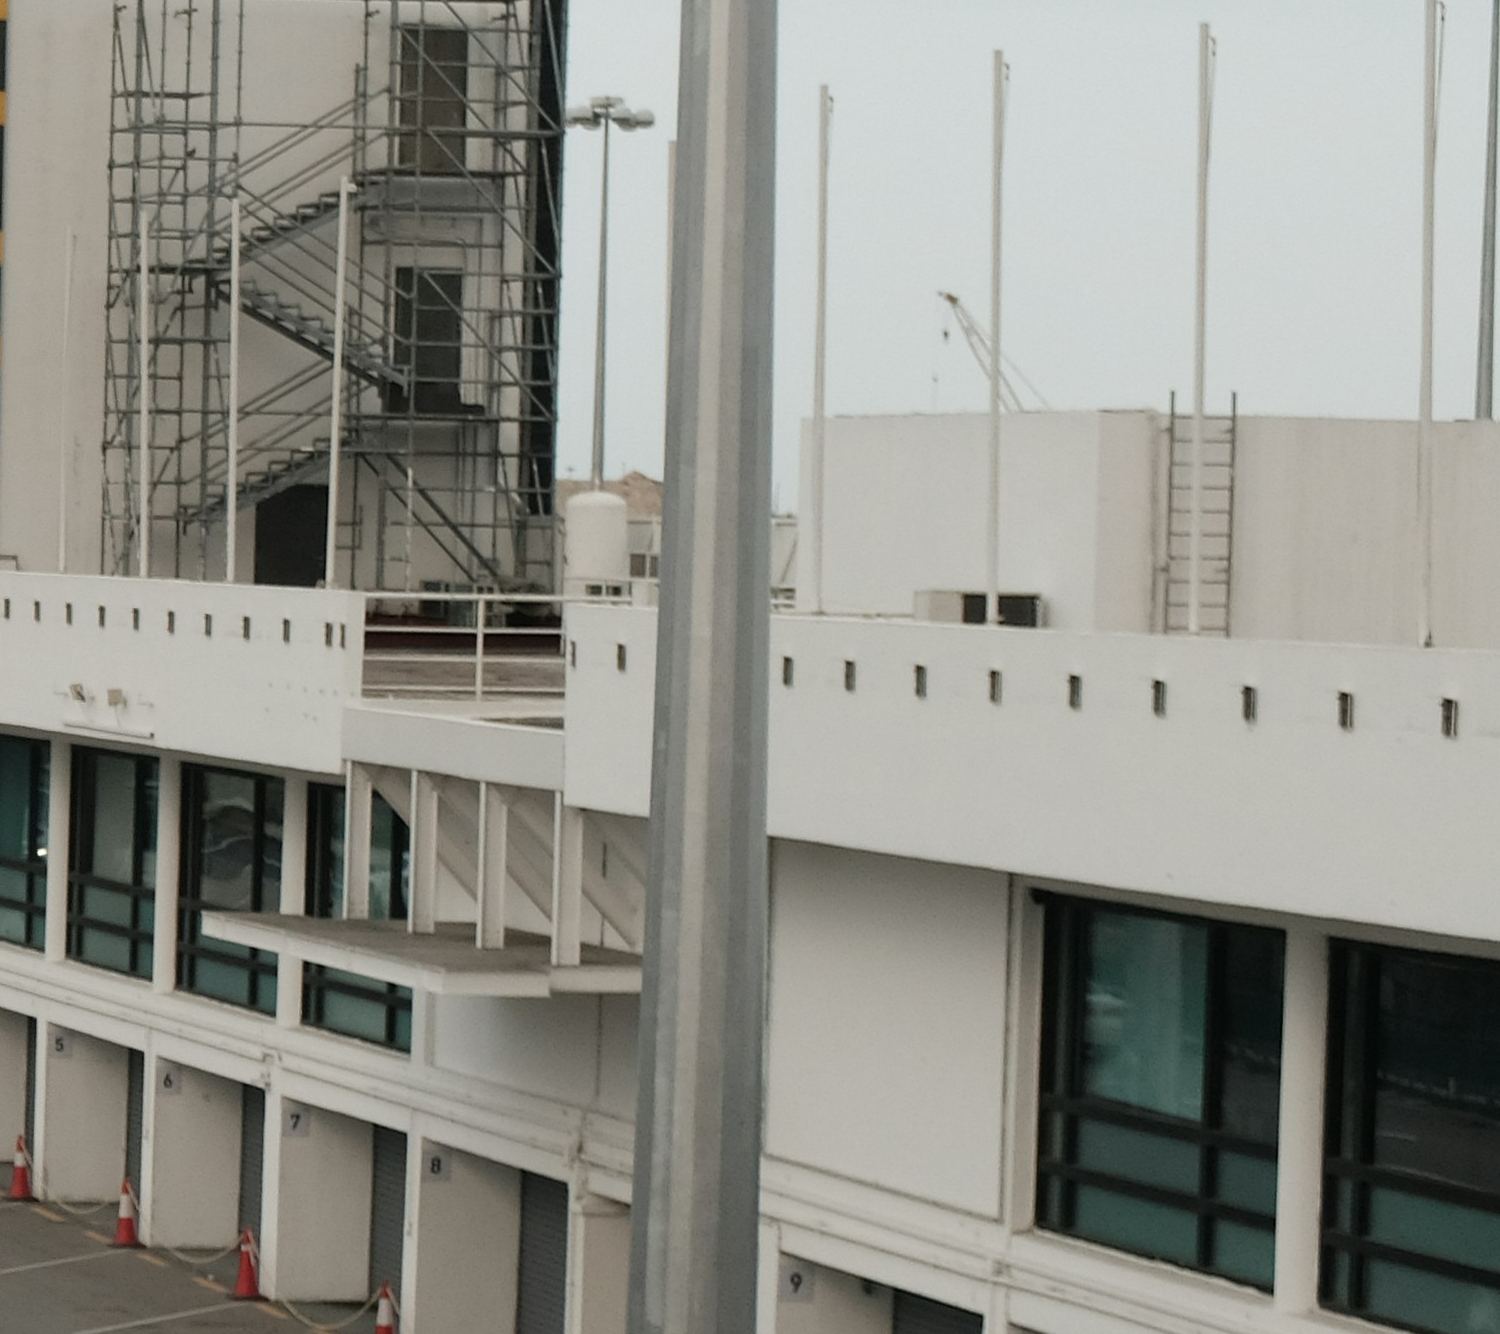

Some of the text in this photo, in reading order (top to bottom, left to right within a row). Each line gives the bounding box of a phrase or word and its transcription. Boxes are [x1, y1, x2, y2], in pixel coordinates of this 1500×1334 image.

[54, 1037, 65, 1053] 5
[162, 1072, 173, 1089] 6
[289, 1113, 301, 1131] 7
[430, 1155, 442, 1175] 8
[790, 1271, 802, 1295] 9
